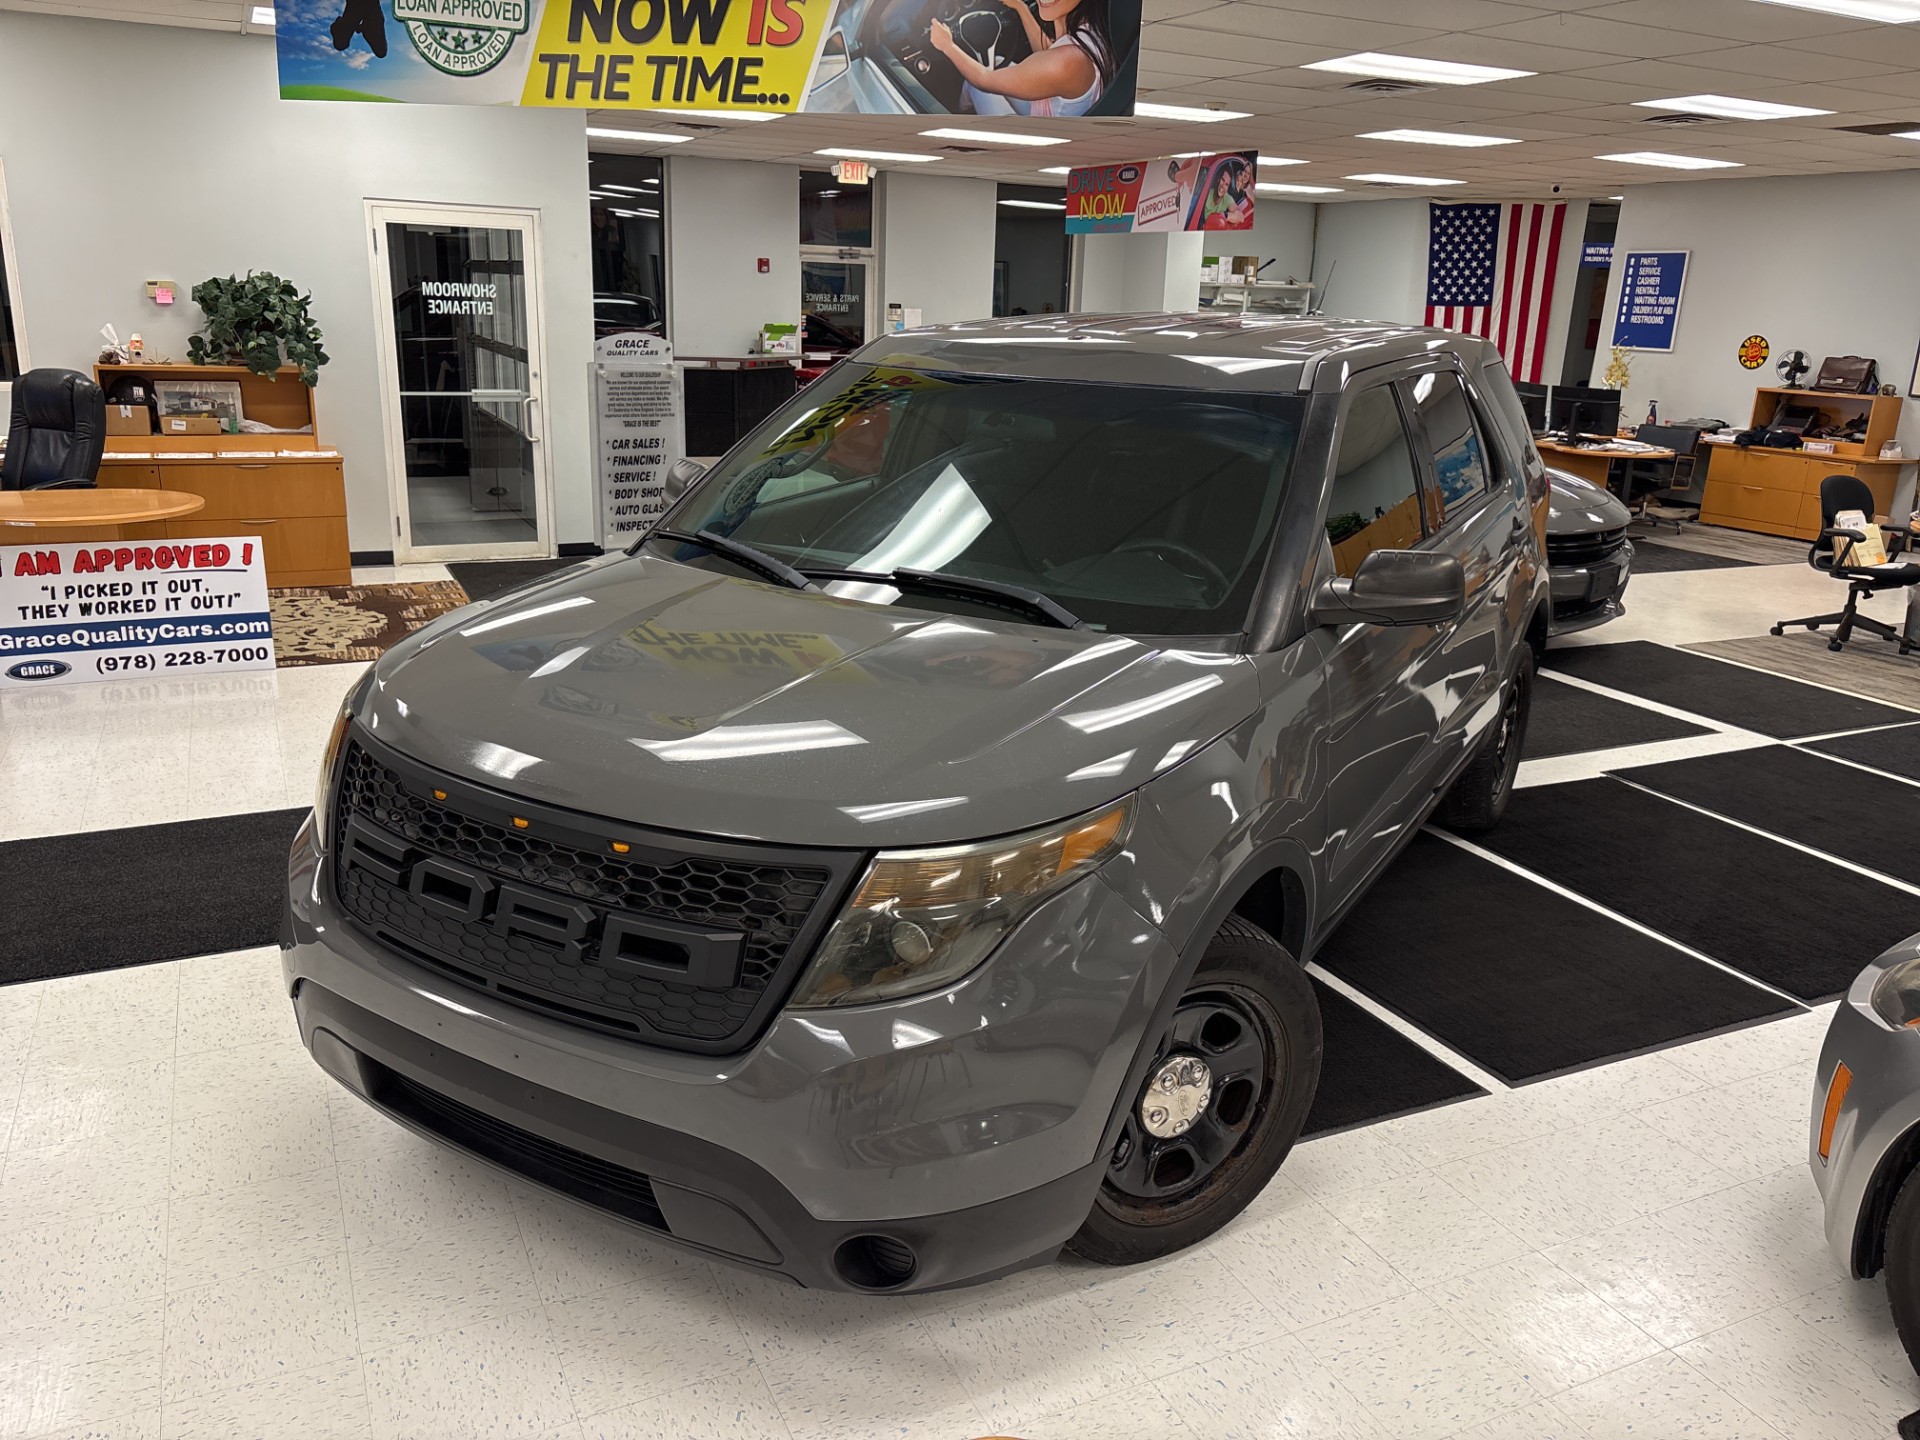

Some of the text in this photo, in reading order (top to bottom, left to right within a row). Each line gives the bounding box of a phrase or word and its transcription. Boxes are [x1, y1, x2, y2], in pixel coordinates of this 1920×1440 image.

[441, 0, 522, 22] APPROVED
[568, 0, 804, 46] NOW IS
[412, 24, 506, 69] LOAN APPROVED
[538, 53, 790, 104] THE TIME...
[843, 161, 865, 181] EXIT
[1069, 167, 1116, 194] DRIVE
[1080, 193, 1127, 220] NOW
[1140, 195, 1176, 218] APPROVED
[1640, 257, 1658, 266] PARTS
[1638, 266, 1661, 275] SERVICE
[1637, 276, 1660, 285] CASHIER
[1635, 286, 1660, 295] RENTALS
[1634, 296, 1676, 305] WAITING ROOM
[1630, 315, 1665, 325] RESTROOMS
[615, 339, 650, 349] GRACE
[1744, 336, 1767, 347] USED
[1741, 357, 1763, 368] CARS
[612, 439, 630, 450] CAR
[632, 438, 660, 449] SALES
[612, 454, 661, 467] FINANCING
[613, 472, 651, 483] SERVICE
[614, 488, 639, 499] BODY
[615, 505, 640, 516] AUTO
[14, 551, 61, 577] AM
[73, 543, 231, 574] APPROVED
[64, 582, 133, 600] PICKED
[141, 581, 158, 595] IT
[168, 579, 209, 594] OUT,
[17, 603, 69, 620] THEY
[78, 598, 156, 617] WORKED
[165, 597, 182, 611] IT
[0, 620, 269, 650] GraceQualityCars.com
[96, 647, 269, 674] (978) 228-7000
[20, 664, 56, 676] GRACE
[342, 813, 746, 988] FORD
